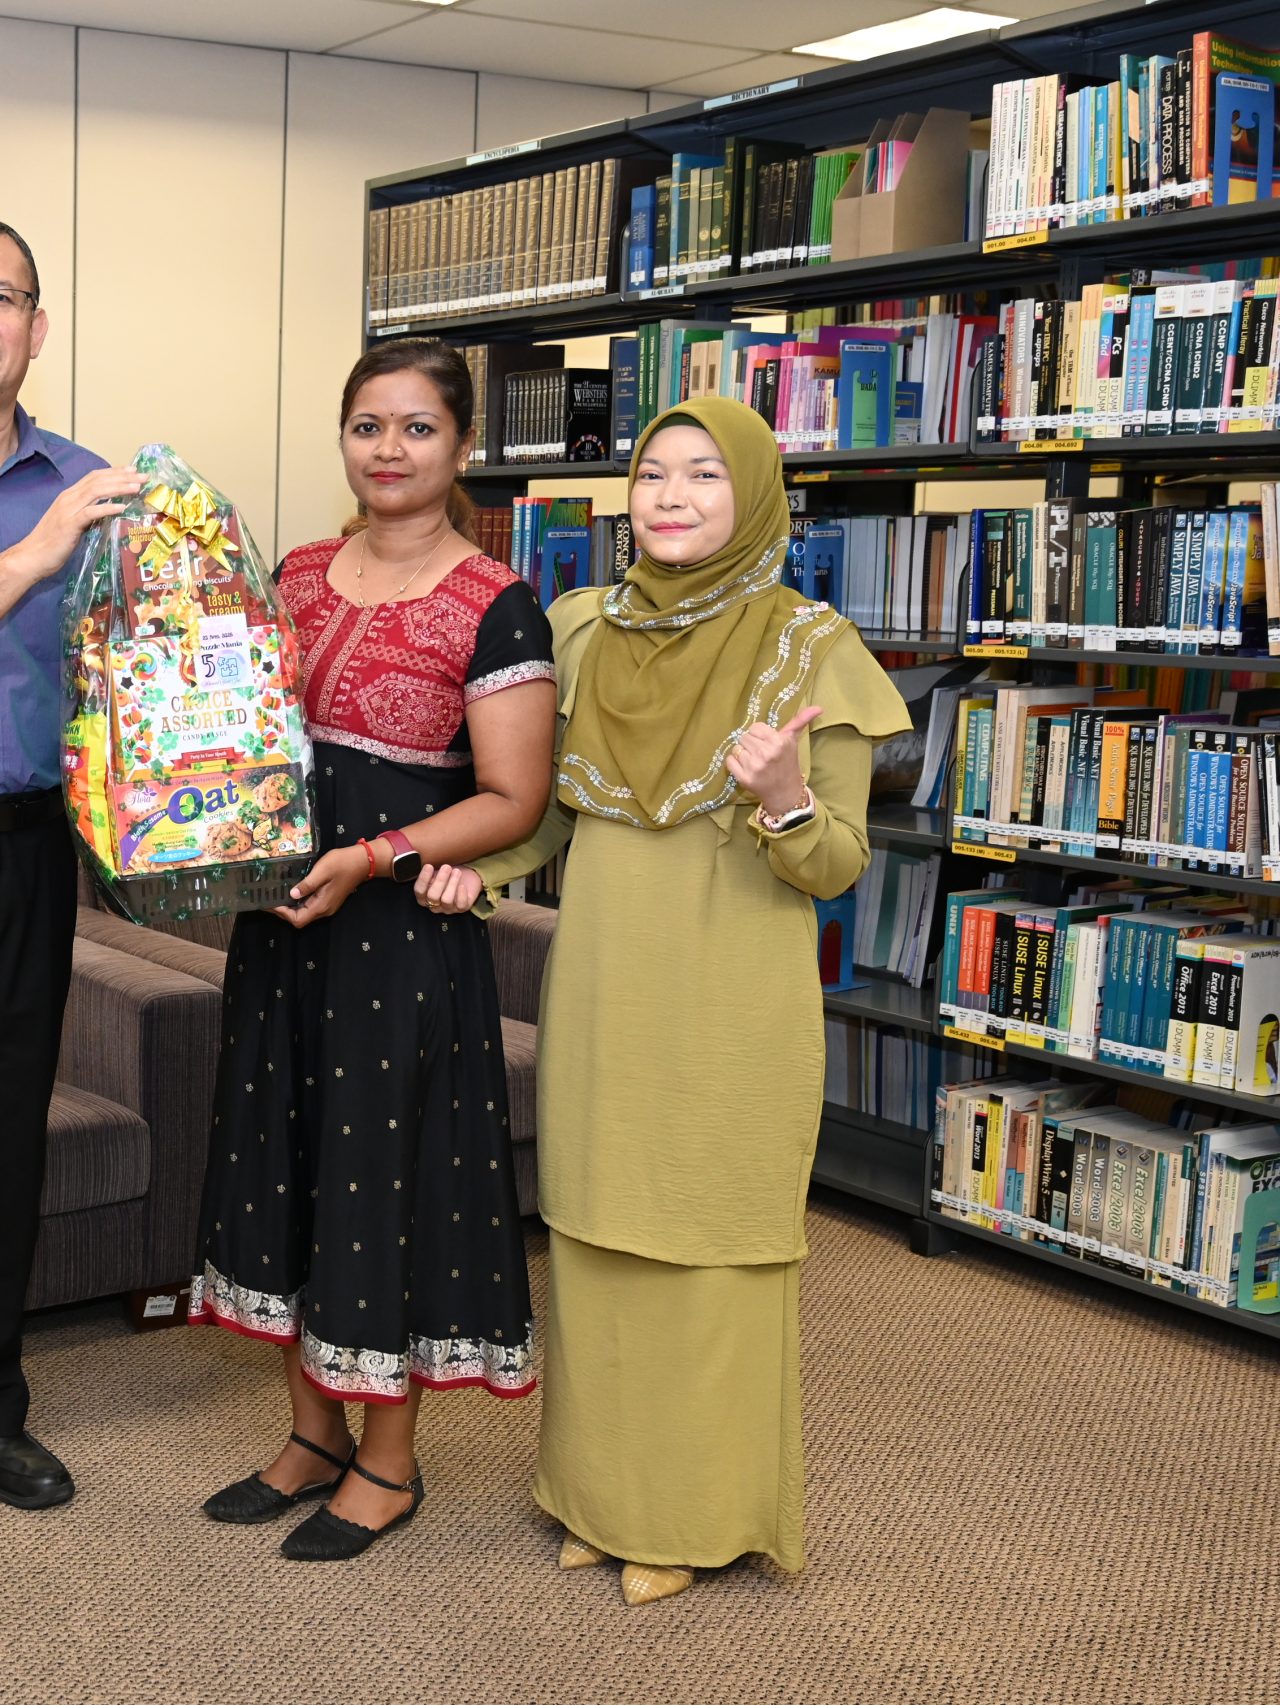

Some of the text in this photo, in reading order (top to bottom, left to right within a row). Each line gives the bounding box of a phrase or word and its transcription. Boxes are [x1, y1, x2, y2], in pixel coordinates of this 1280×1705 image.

[731, 87, 770, 101] DICTIONARY
[1162, 96, 1173, 121] DATA
[484, 146, 520, 160] ENCYCLOPEDIA
[1162, 122, 1172, 174] PROCESS
[987, 241, 1006, 249] 001.00
[1238, 300, 1251, 355] Practical Liferay
[1256, 301, 1269, 364] Cisco Networking
[1043, 351, 1049, 362] PC
[1100, 335, 1109, 356] iPad
[1112, 336, 1123, 355] PCs
[1193, 322, 1204, 379] CCNA ICND2
[1214, 319, 1227, 373] CCNP ONT
[766, 362, 776, 385] LAW
[1161, 324, 1175, 410] CCENT/CCNA ICND1
[615, 524, 623, 571] OXFORD
[622, 523, 630, 570] CONCISE
[1049, 509, 1069, 568] PL/I
[139, 556, 203, 582] Bear
[1159, 537, 1167, 577] Introduction
[1170, 532, 1185, 597] SIMPLY JAVA
[1186, 532, 1203, 596] SIMPLY JAVA
[204, 576, 232, 585] biscuits
[208, 591, 242, 607] tasty &
[209, 605, 245, 617] creamy
[1155, 587, 1163, 622] Computing
[1206, 583, 1217, 622] JavaScript
[1228, 583, 1238, 622] JavaScript
[201, 654, 216, 678] 5
[171, 690, 233, 713] CHOICE
[161, 708, 247, 734] ASSORTED
[1106, 725, 1124, 734] 100%
[980, 723, 990, 781] COMPUTING
[1077, 715, 1090, 778] Visual Basic .NET
[1090, 716, 1103, 780] Visual Basic .NET
[1129, 745, 1138, 756] SQL
[1145, 746, 1155, 757] SQL
[1128, 757, 1136, 778] SERVER
[1144, 758, 1153, 778] SERVER
[1128, 779, 1136, 790] 2005
[1144, 780, 1152, 791] 2005
[1185, 753, 1200, 845] WINDOWS ADMINISTRATOR
[168, 779, 240, 824] Oat
[204, 810, 235, 824] Cookies
[1125, 798, 1134, 833] DEVELOPERS
[1140, 801, 1150, 834] DEVELOPERS
[1198, 789, 1206, 819] SOURCE
[1206, 756, 1220, 849] WINDOWS ADMINISTRATOR
[1217, 791, 1226, 821] SOURCE
[1235, 758, 1249, 853] OPEN SOURCE SOLUTIONS
[143, 809, 168, 829] Sesame
[1098, 820, 1119, 830] Bible
[954, 844, 975, 853] 005.133
[994, 851, 1013, 859] 005.43
[949, 905, 958, 936] UNIX
[1013, 936, 1028, 995] SUSE Linux
[1032, 939, 1049, 1000] SUSE Linux
[1176, 966, 1190, 1015] Office 2013
[1208, 972, 1221, 1016] Excel 2013
[1229, 974, 1238, 1006] PowerPoint
[949, 1029, 970, 1039] 005.432
[1071, 1153, 1087, 1217] Word 2003
[1089, 1158, 1105, 1222] Word 2003
[1108, 1160, 1127, 1232] Excel 2003
[1132, 1167, 1149, 1240] Excel 2003
